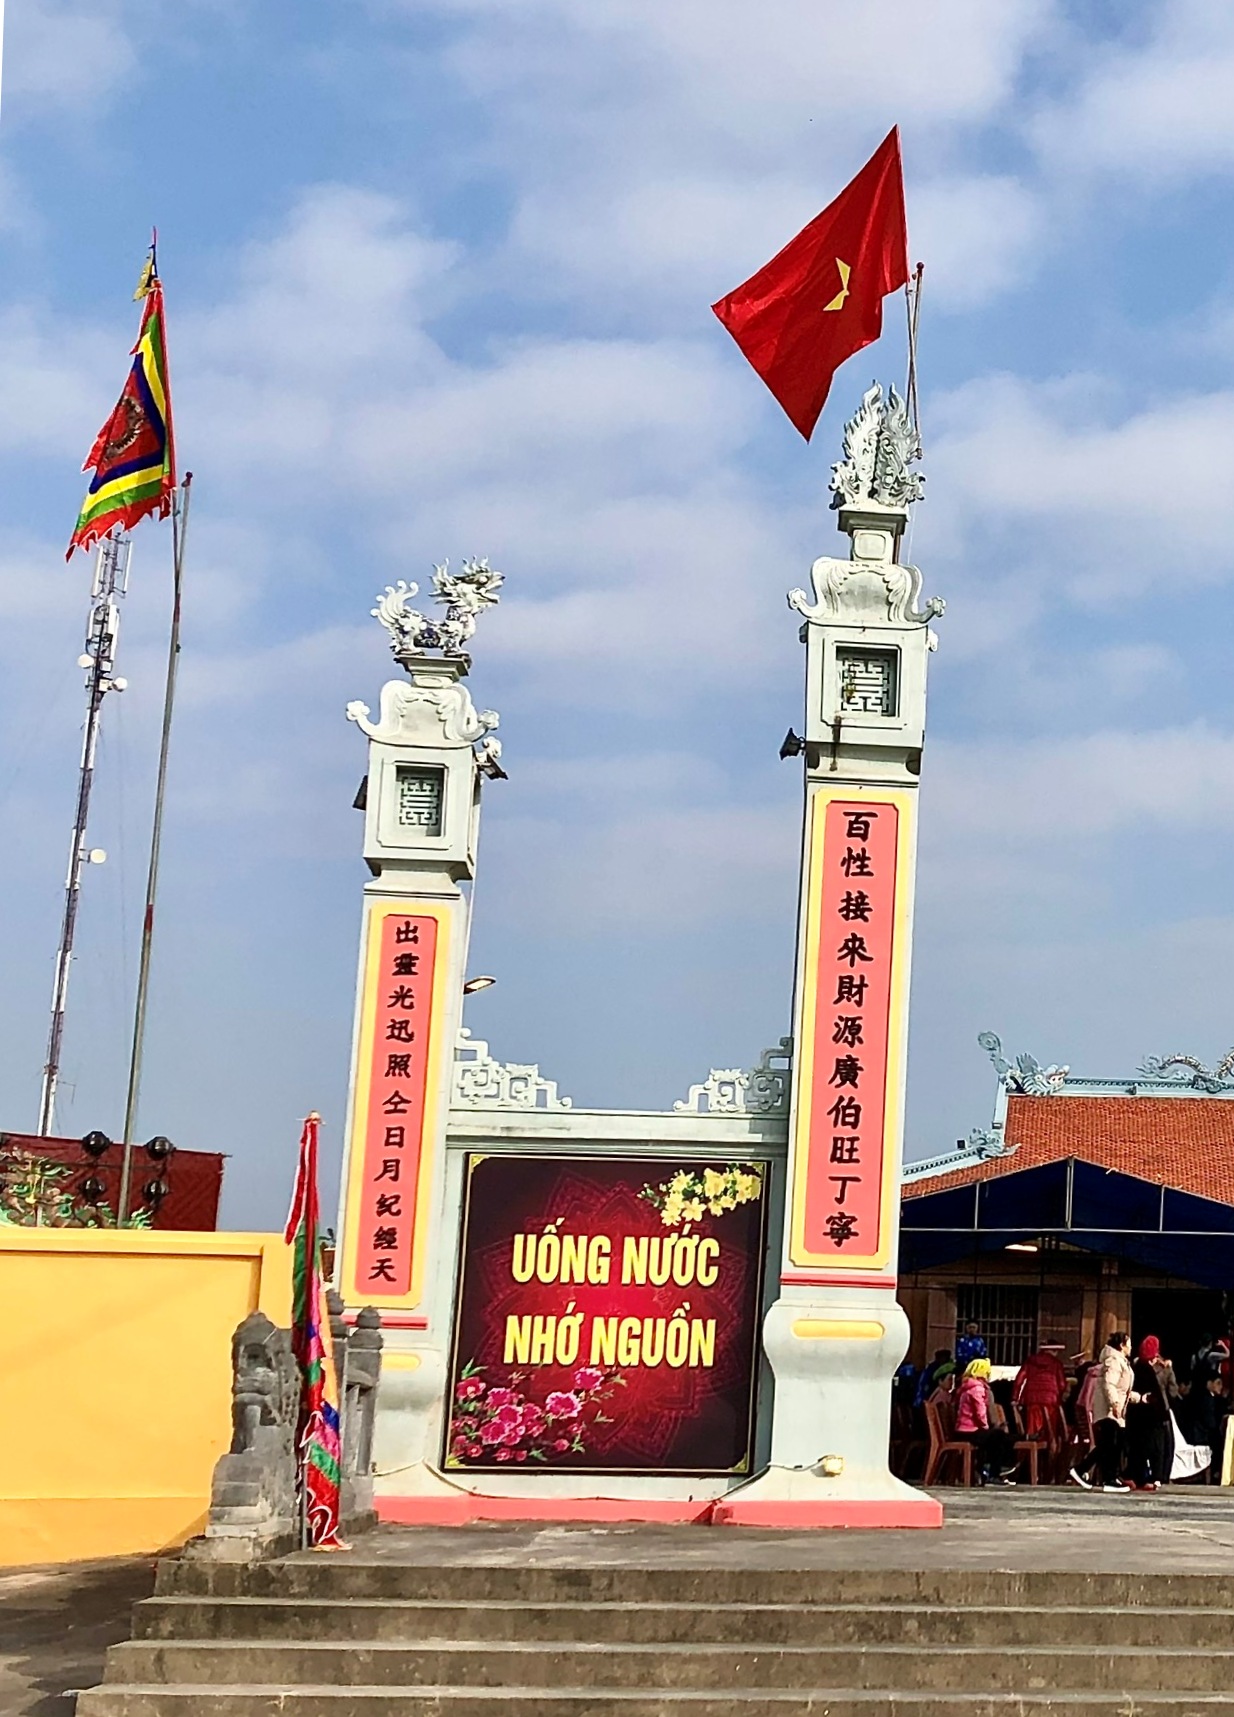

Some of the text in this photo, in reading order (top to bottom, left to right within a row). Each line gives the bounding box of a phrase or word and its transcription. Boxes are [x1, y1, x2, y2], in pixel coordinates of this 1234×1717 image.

[513, 1218, 719, 1286] UỐNG NƯỚC
[504, 1302, 716, 1367] NHỚ NGUỒN
